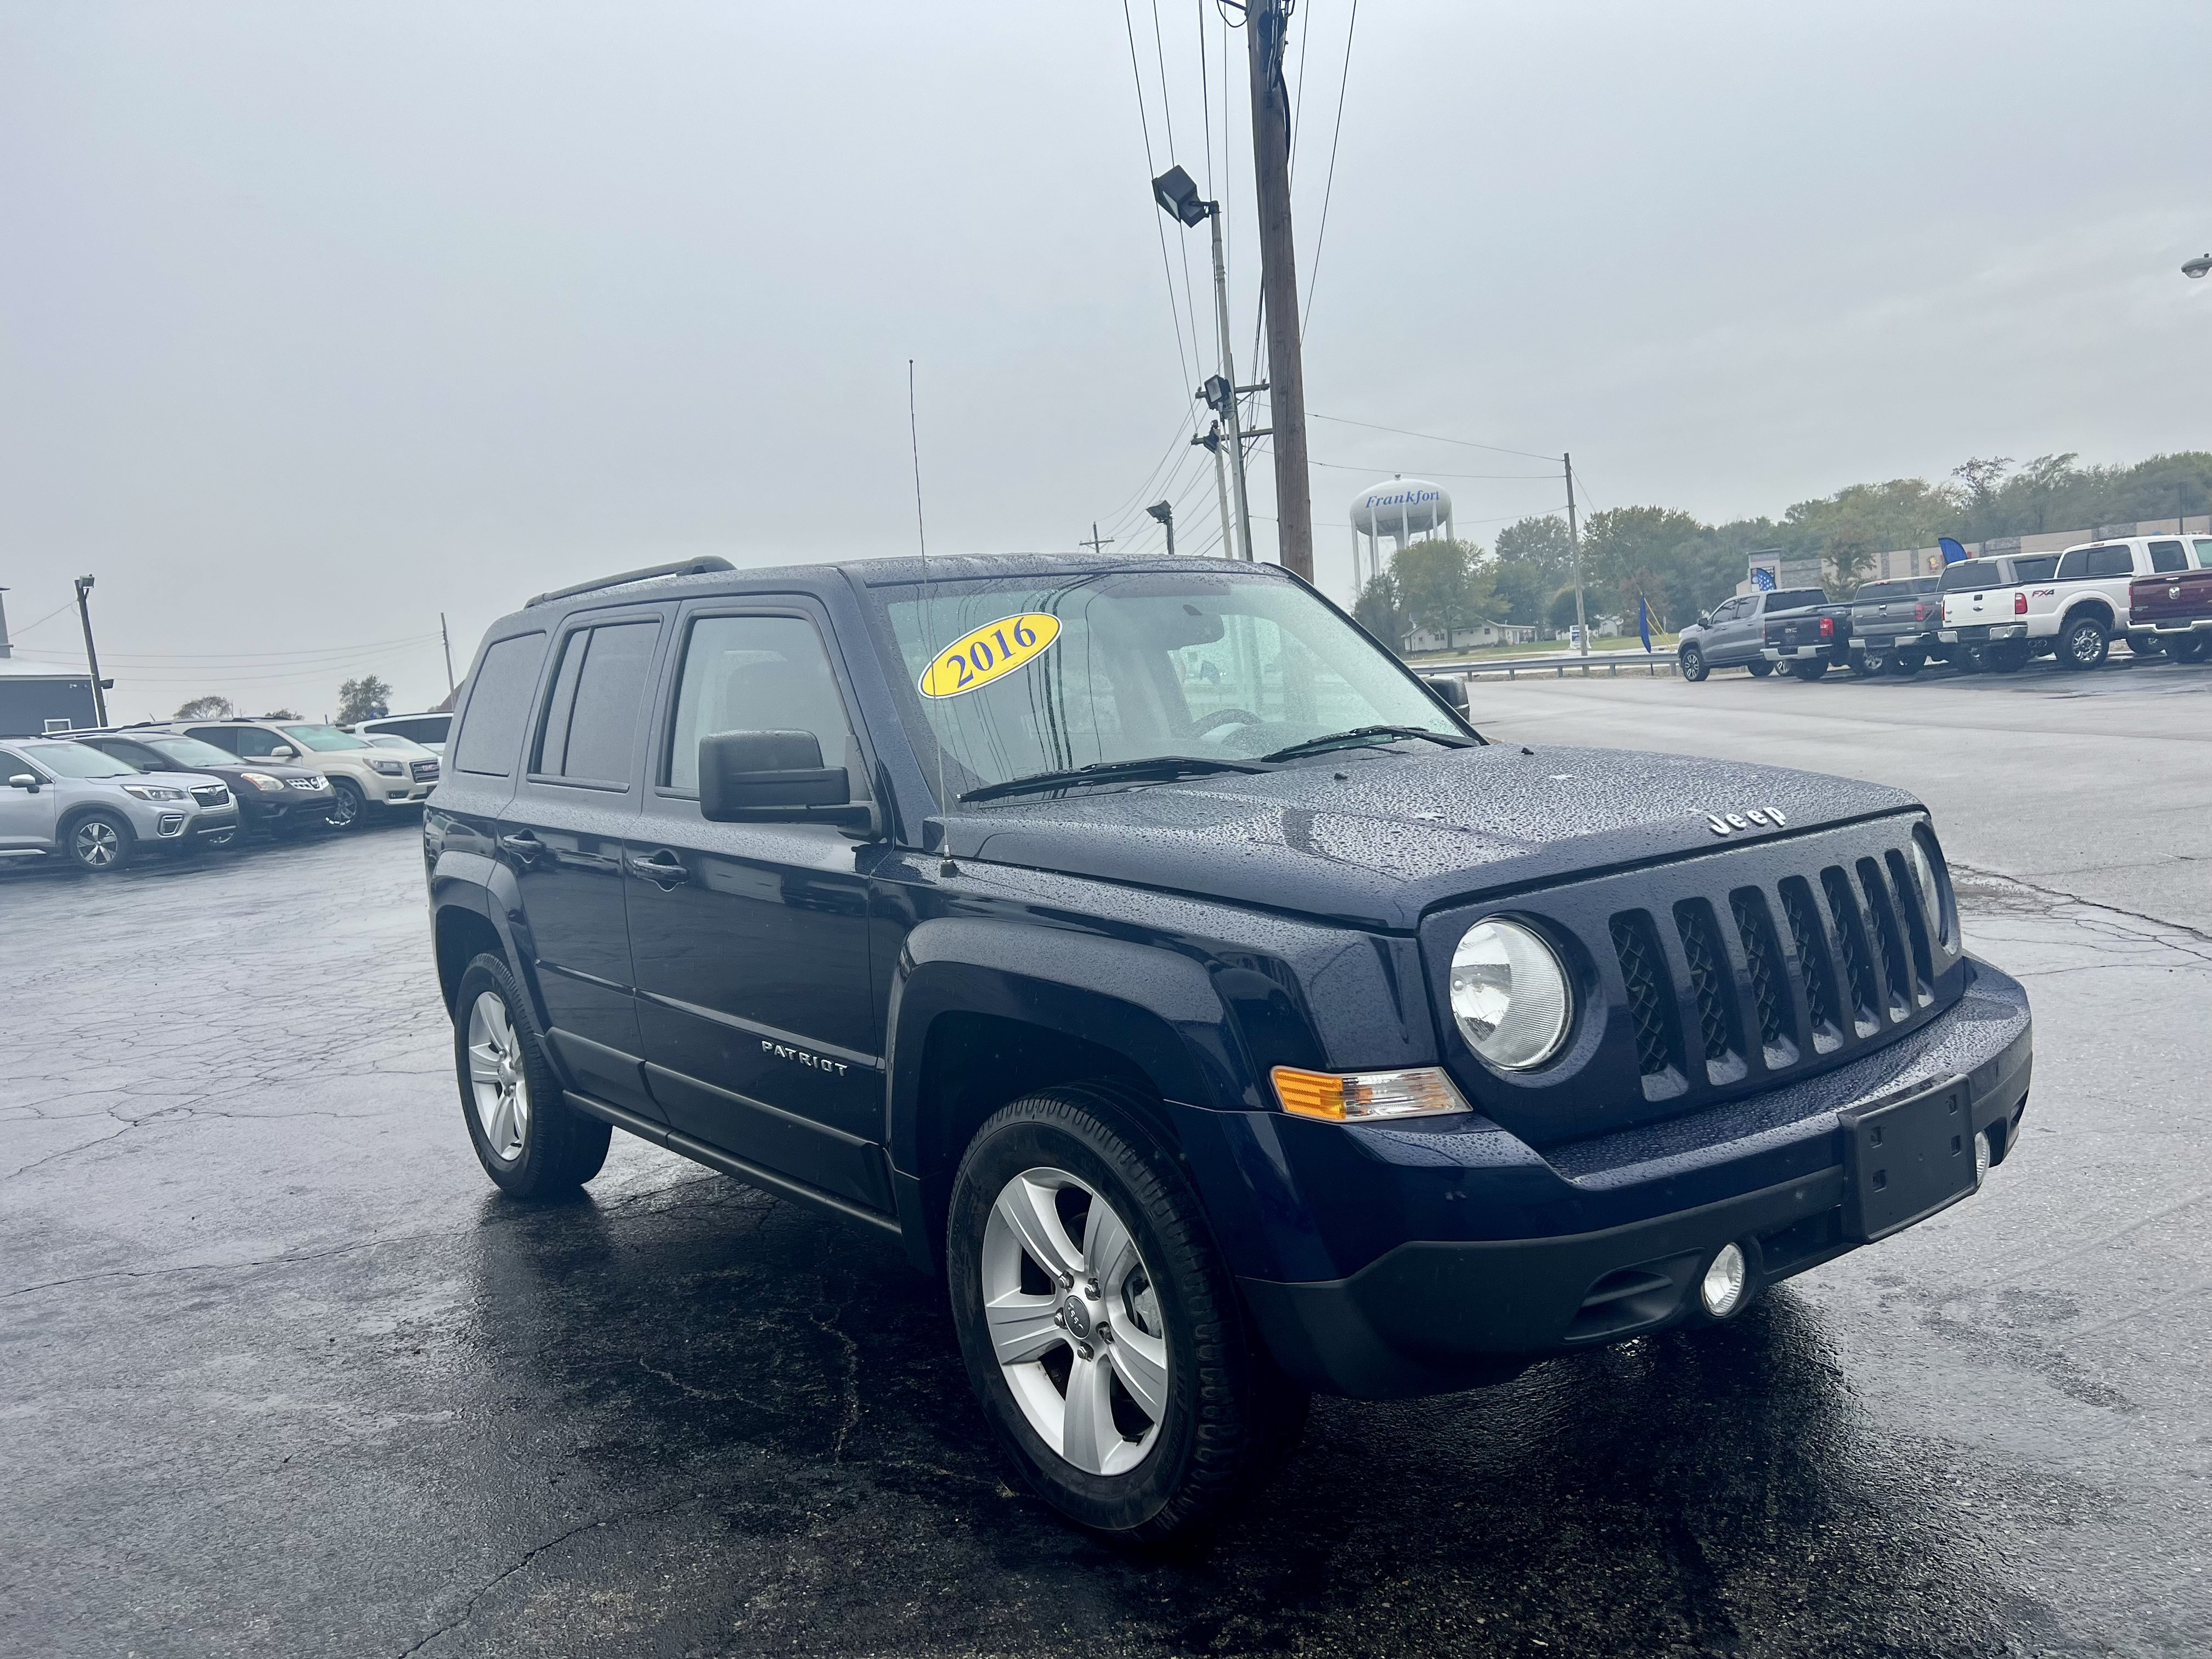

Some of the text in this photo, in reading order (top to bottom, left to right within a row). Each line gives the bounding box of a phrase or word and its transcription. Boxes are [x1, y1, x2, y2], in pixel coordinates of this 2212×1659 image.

[1365, 489, 1440, 509] Frankfort
[2032, 589, 2055, 597] FX4
[946, 617, 1036, 689] 2016
[1707, 806, 1787, 835] Jeep
[761, 1040, 849, 1077] PATRIOT
